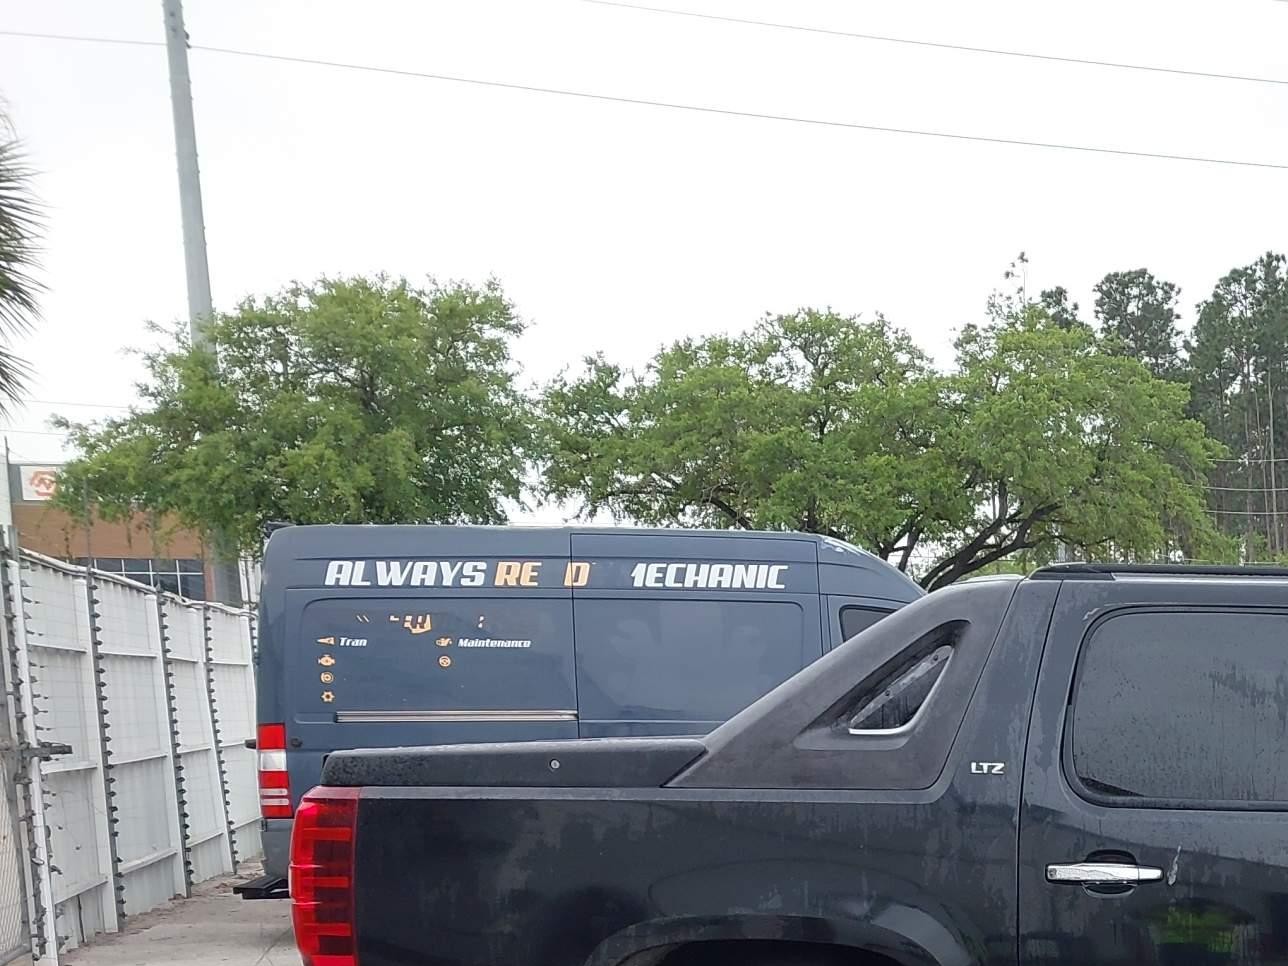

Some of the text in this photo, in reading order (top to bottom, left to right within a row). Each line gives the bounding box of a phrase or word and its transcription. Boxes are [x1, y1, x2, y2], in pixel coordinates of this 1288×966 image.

[324, 560, 488, 587] ALWAYS
[340, 637, 368, 647] Tran
[458, 638, 532, 648] Maintenance
[971, 762, 1005, 774] LTZ
